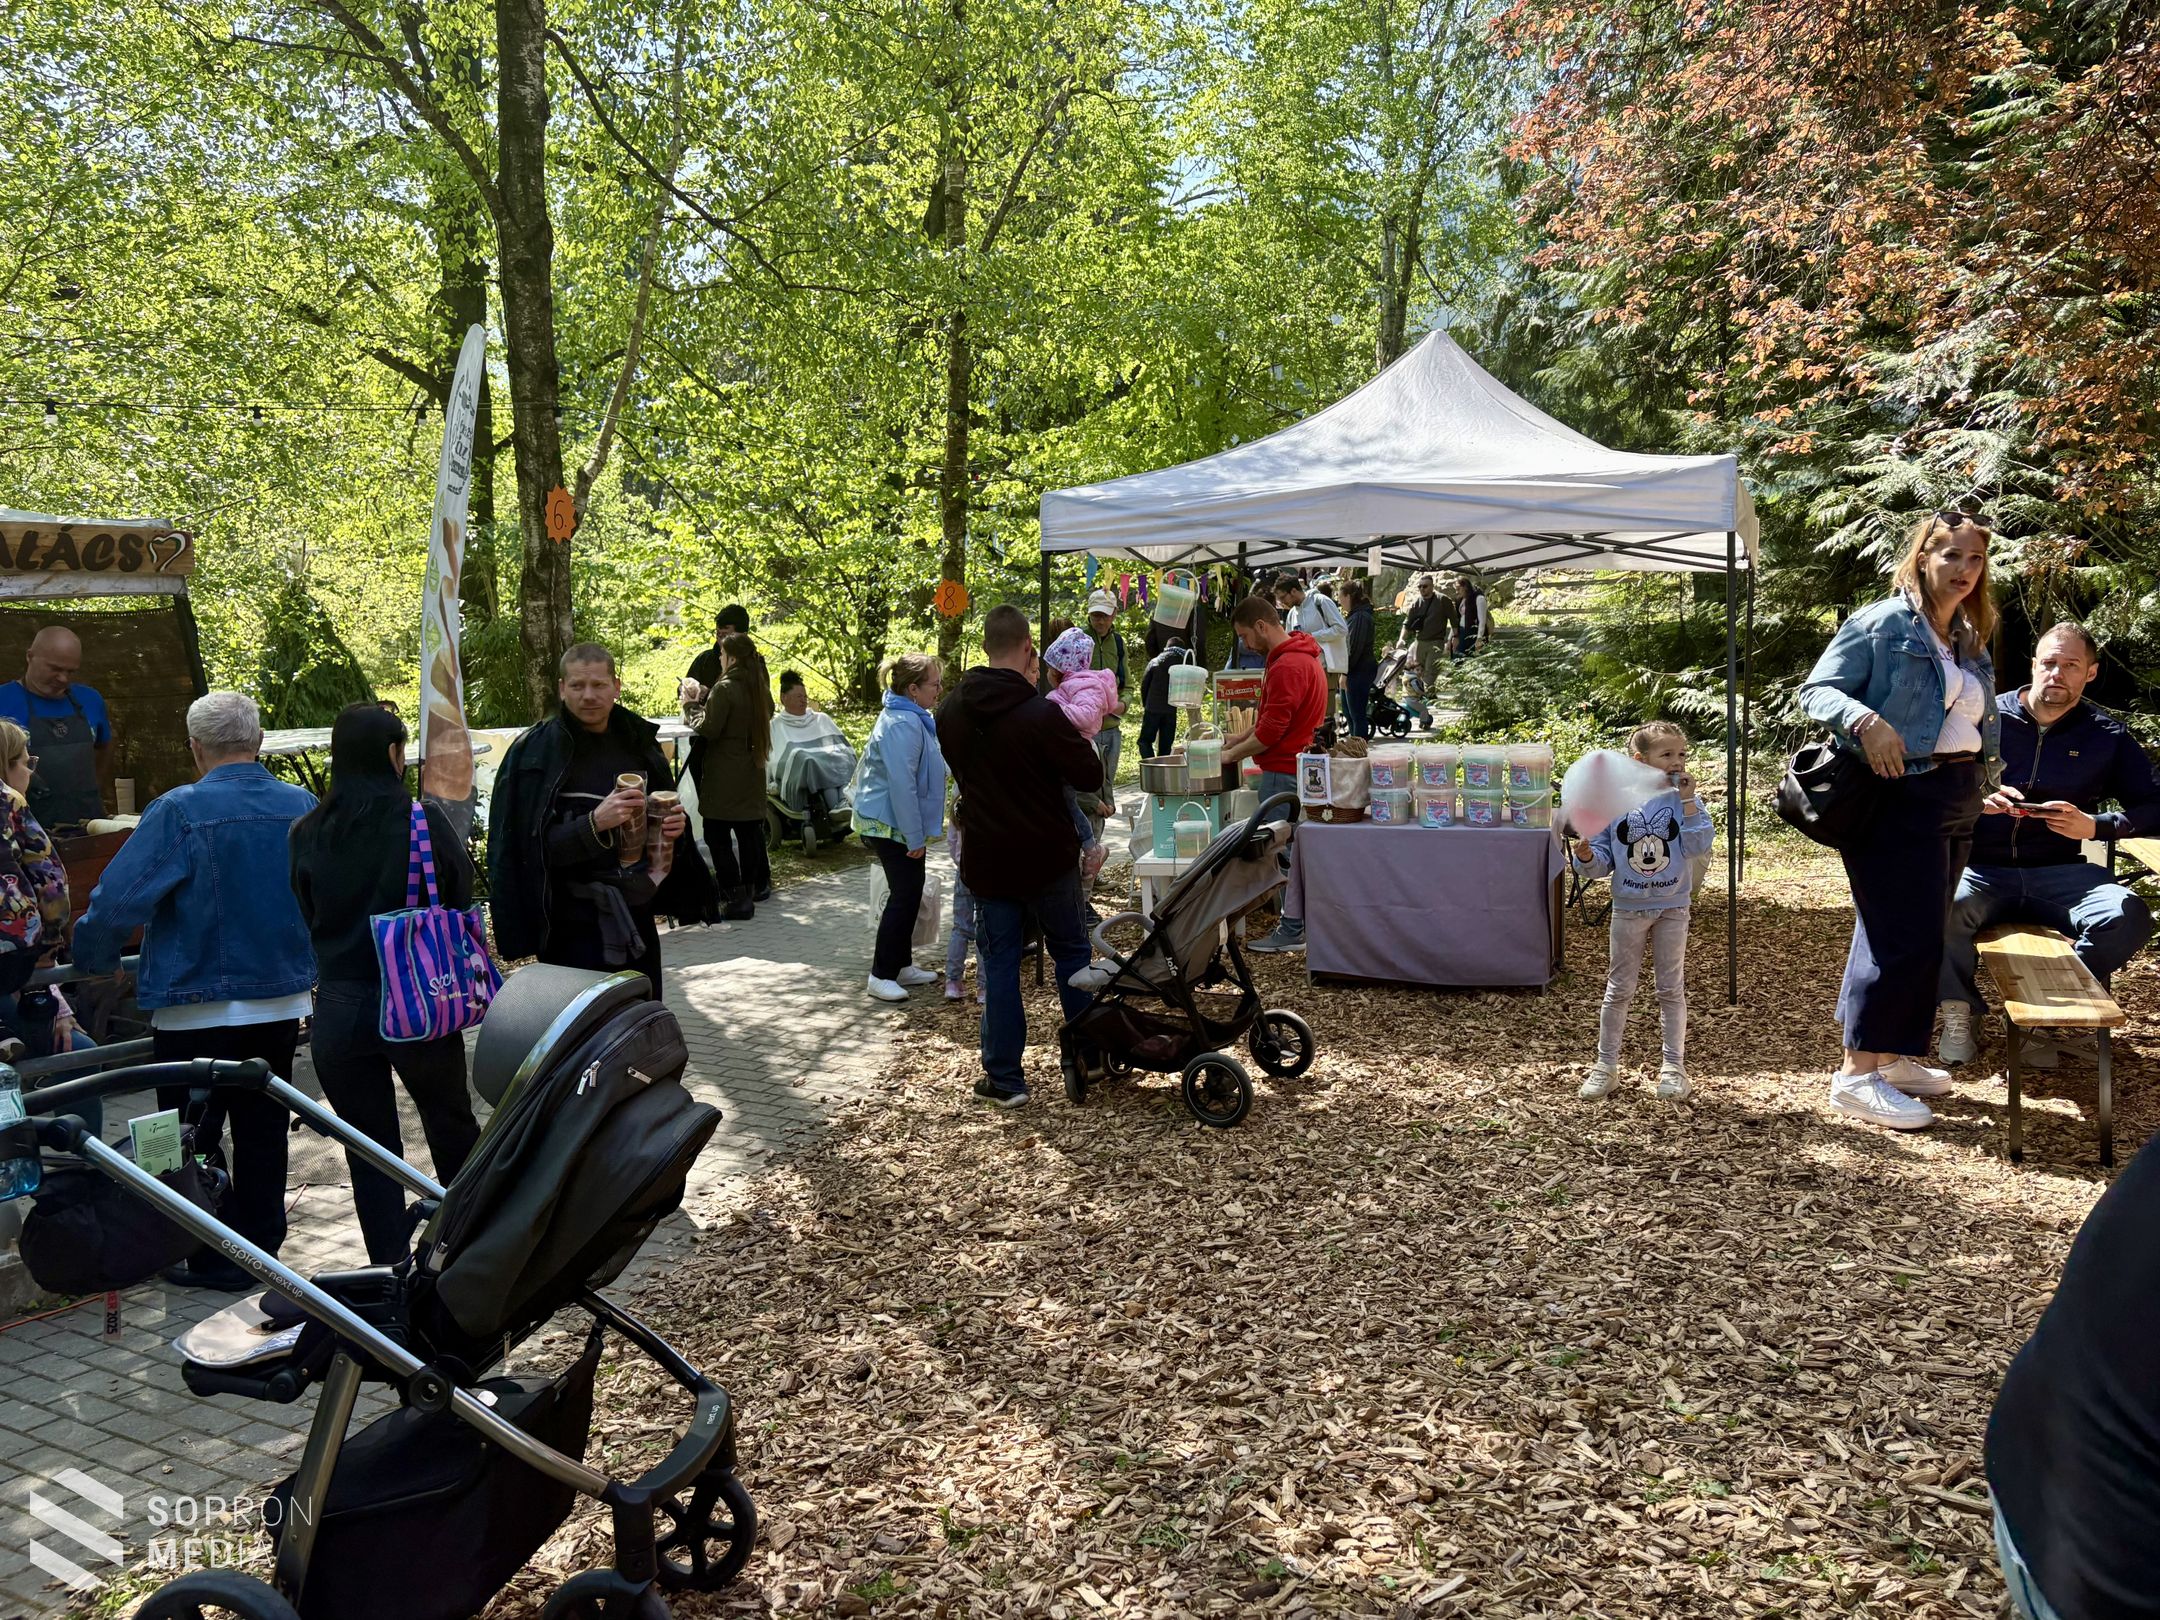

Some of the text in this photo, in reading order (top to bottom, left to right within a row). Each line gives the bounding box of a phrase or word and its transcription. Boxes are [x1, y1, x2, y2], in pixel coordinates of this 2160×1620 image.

[554, 499, 567, 531] 6.
[944, 586, 957, 610] 8.
[1623, 877, 1679, 890] Minnie Mouse
[221, 1239, 304, 1298] espiro next up
[106, 1310, 118, 1335] 2025
